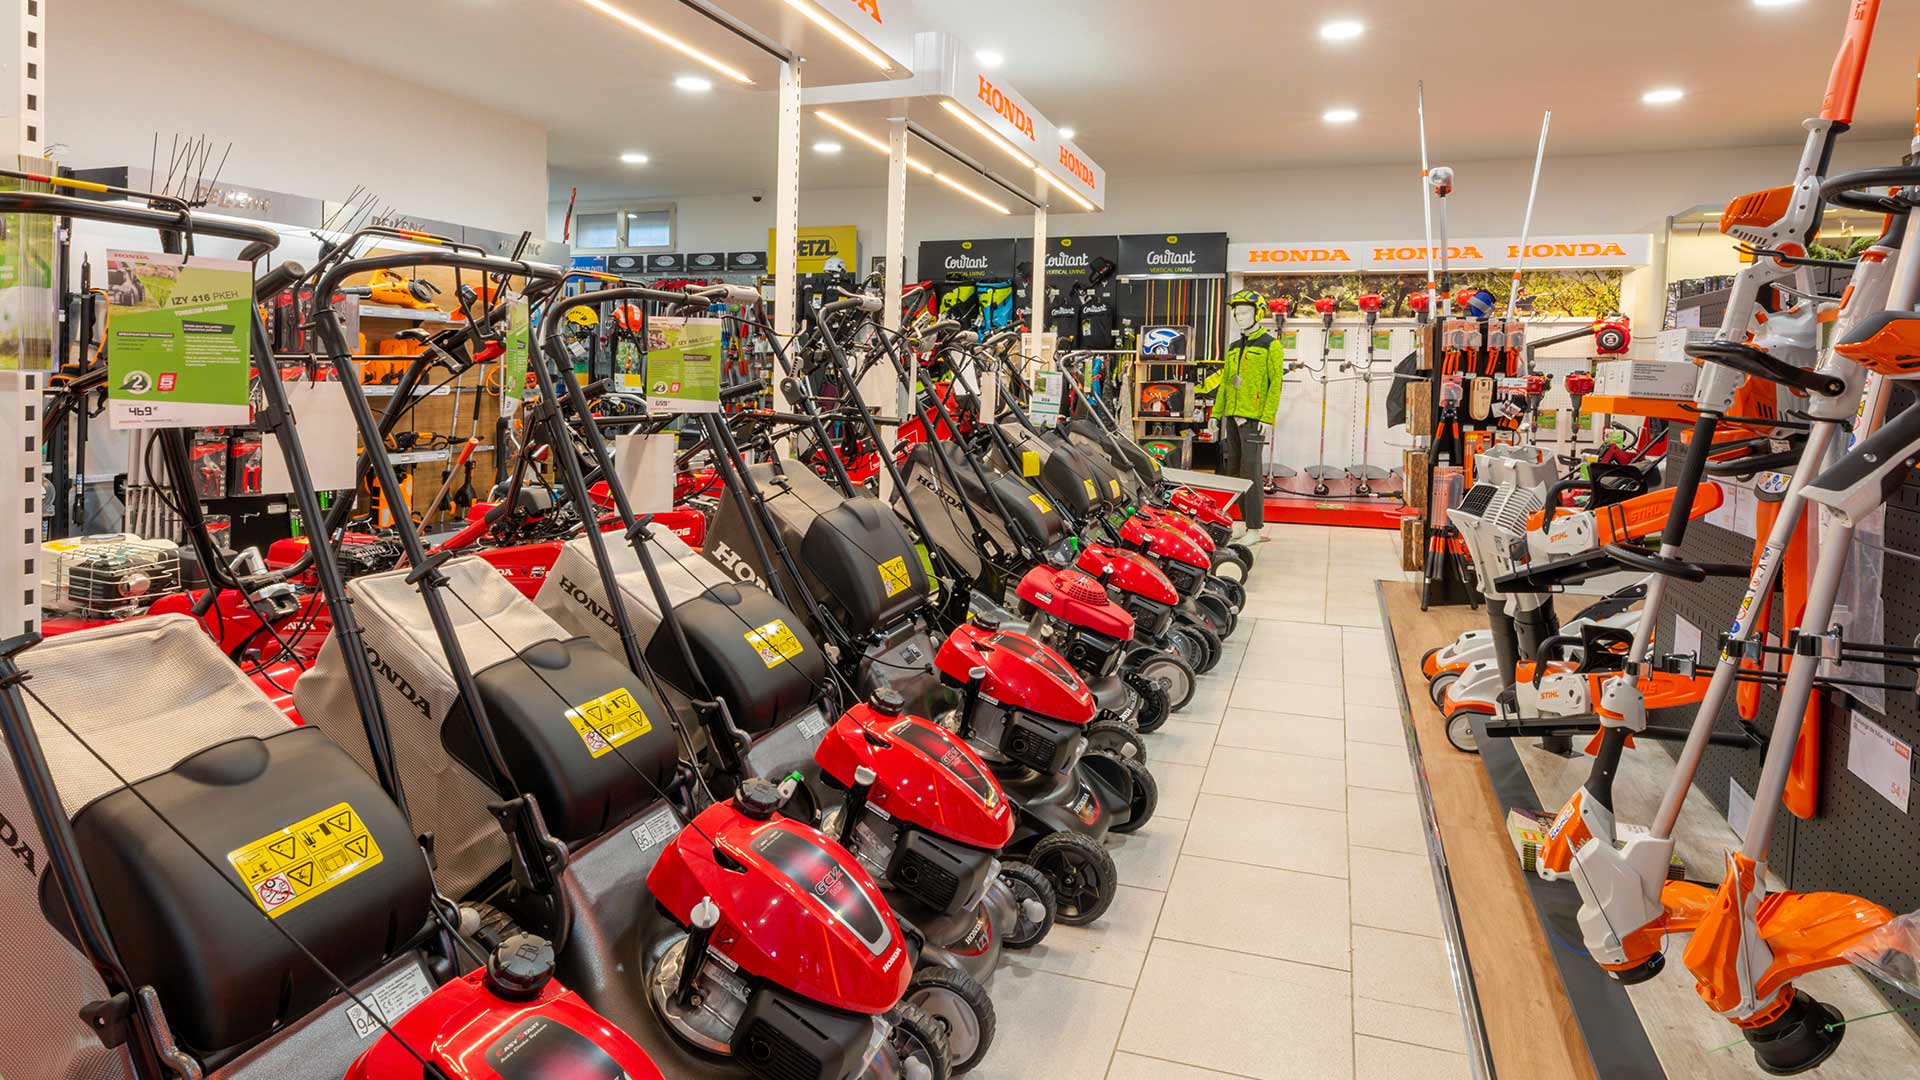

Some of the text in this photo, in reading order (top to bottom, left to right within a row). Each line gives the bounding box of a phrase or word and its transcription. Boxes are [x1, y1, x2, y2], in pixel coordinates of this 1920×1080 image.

[978, 74, 1035, 142] HONDA
[1059, 144, 1095, 190] HONDA
[797, 239, 839, 257] ETZL
[1248, 249, 1351, 263] HONDA
[1372, 246, 1484, 261] HONDA
[1507, 242, 1627, 258] HONDA
[944, 254, 989, 269] Courant
[1045, 251, 1089, 267] Courant
[1146, 249, 1197, 265] Courant
[171, 290, 239, 306] IZY 416 PKEH
[1549, 532, 1569, 544] STIHL
[363, 641, 432, 720] ONDA
[1540, 690, 1559, 700] STIHL
[881, 947, 902, 973] HONDA
